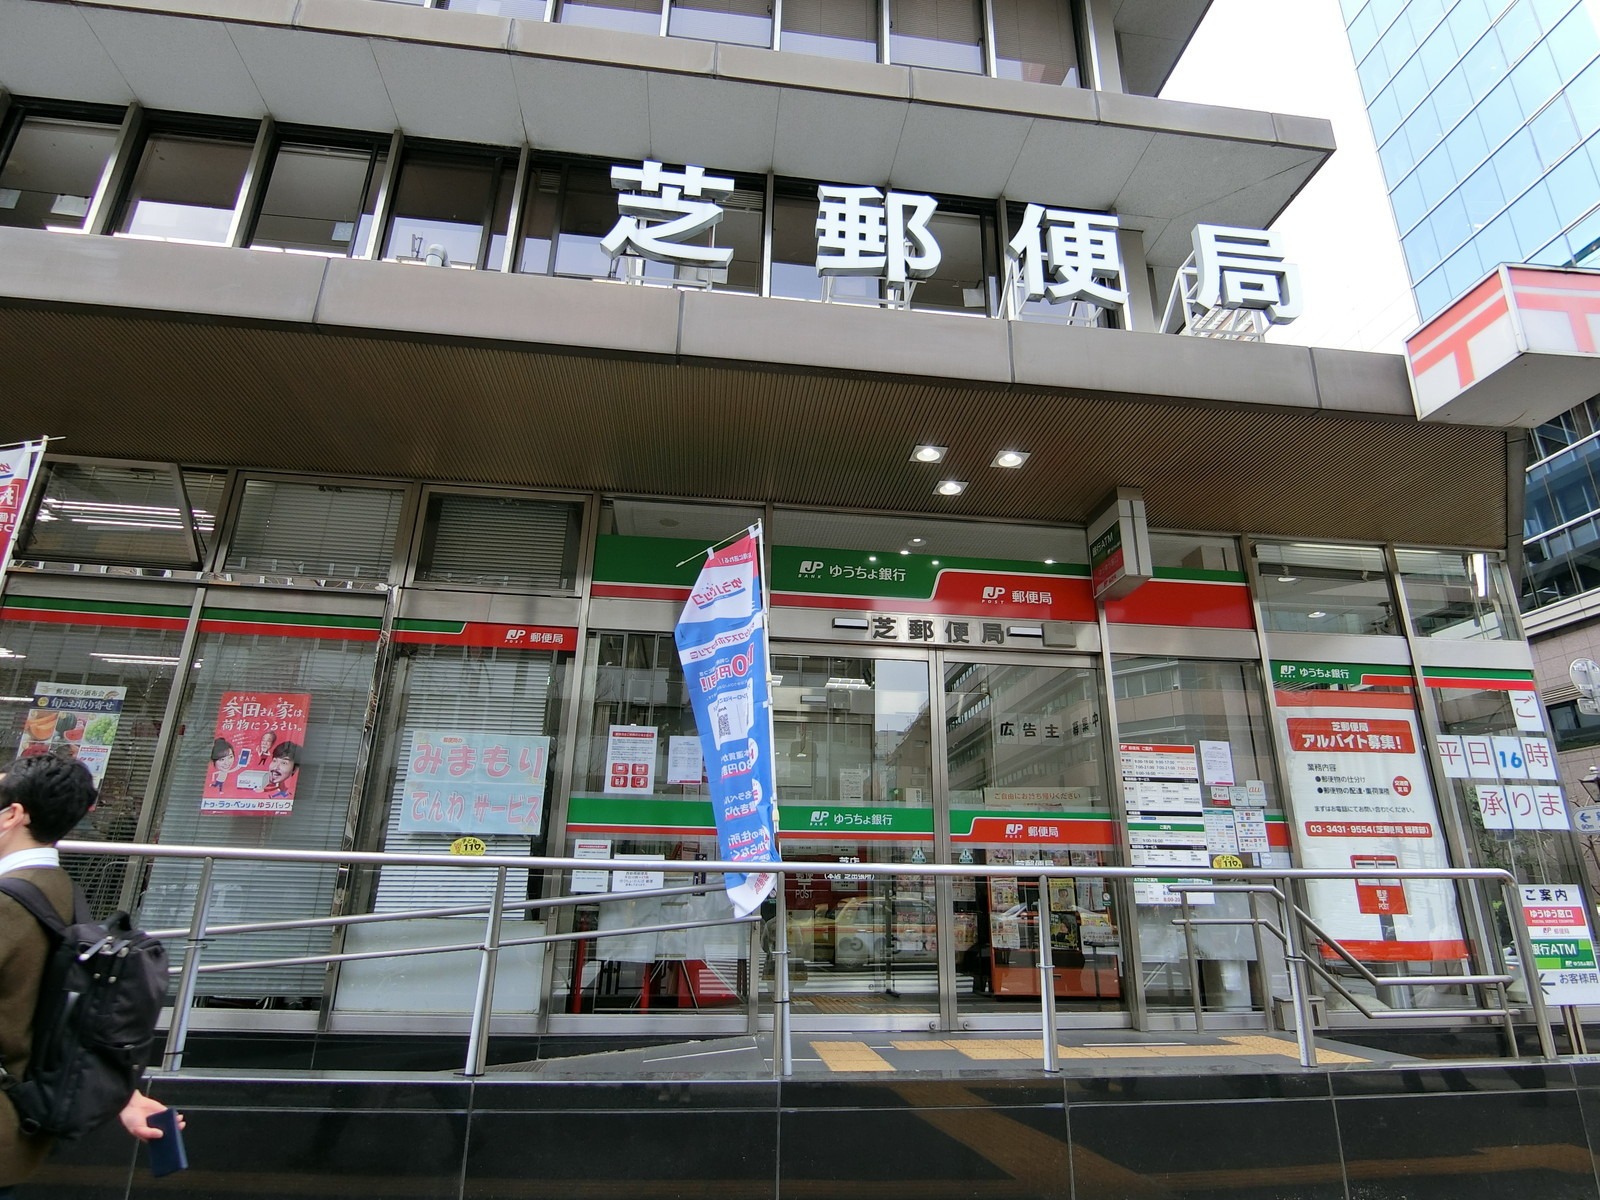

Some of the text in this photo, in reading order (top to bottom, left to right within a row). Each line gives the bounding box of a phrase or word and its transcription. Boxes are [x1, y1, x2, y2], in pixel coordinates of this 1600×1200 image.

[600, 160, 1302, 326] 芝郵便局
[829, 564, 906, 582] ゆうちょ銀行
[1011, 590, 1053, 605] 郵便局
[872, 616, 1005, 645] 芝郵便局
[530, 632, 564, 645] 郵便局
[1299, 668, 1350, 679] ゆうちょ銀行
[222, 696, 306, 720] 参田さん家は、
[1514, 696, 1536, 720] ご
[222, 719, 303, 732] 荷物にうるさい。
[1331, 721, 1369, 732] 芝郵便局
[1302, 733, 1402, 750] アルバイト募集!
[413, 743, 545, 779] みまもり
[1439, 742, 1550, 769] 平日16時
[1307, 764, 1337, 772] 業務内容
[994, 792, 1081, 800] ご自由にお持ち帰りください
[411, 791, 541, 825] でんわ サービス
[1481, 789, 1563, 818] 承りま
[833, 813, 893, 827] ゆうちょ銀行
[1028, 826, 1059, 838] 郵便局
[795, 889, 814, 899] POST
[1525, 888, 1568, 902] ご案内
[1529, 909, 1574, 918] ゆうゆう窓口
[1559, 973, 1599, 984] お客様用
